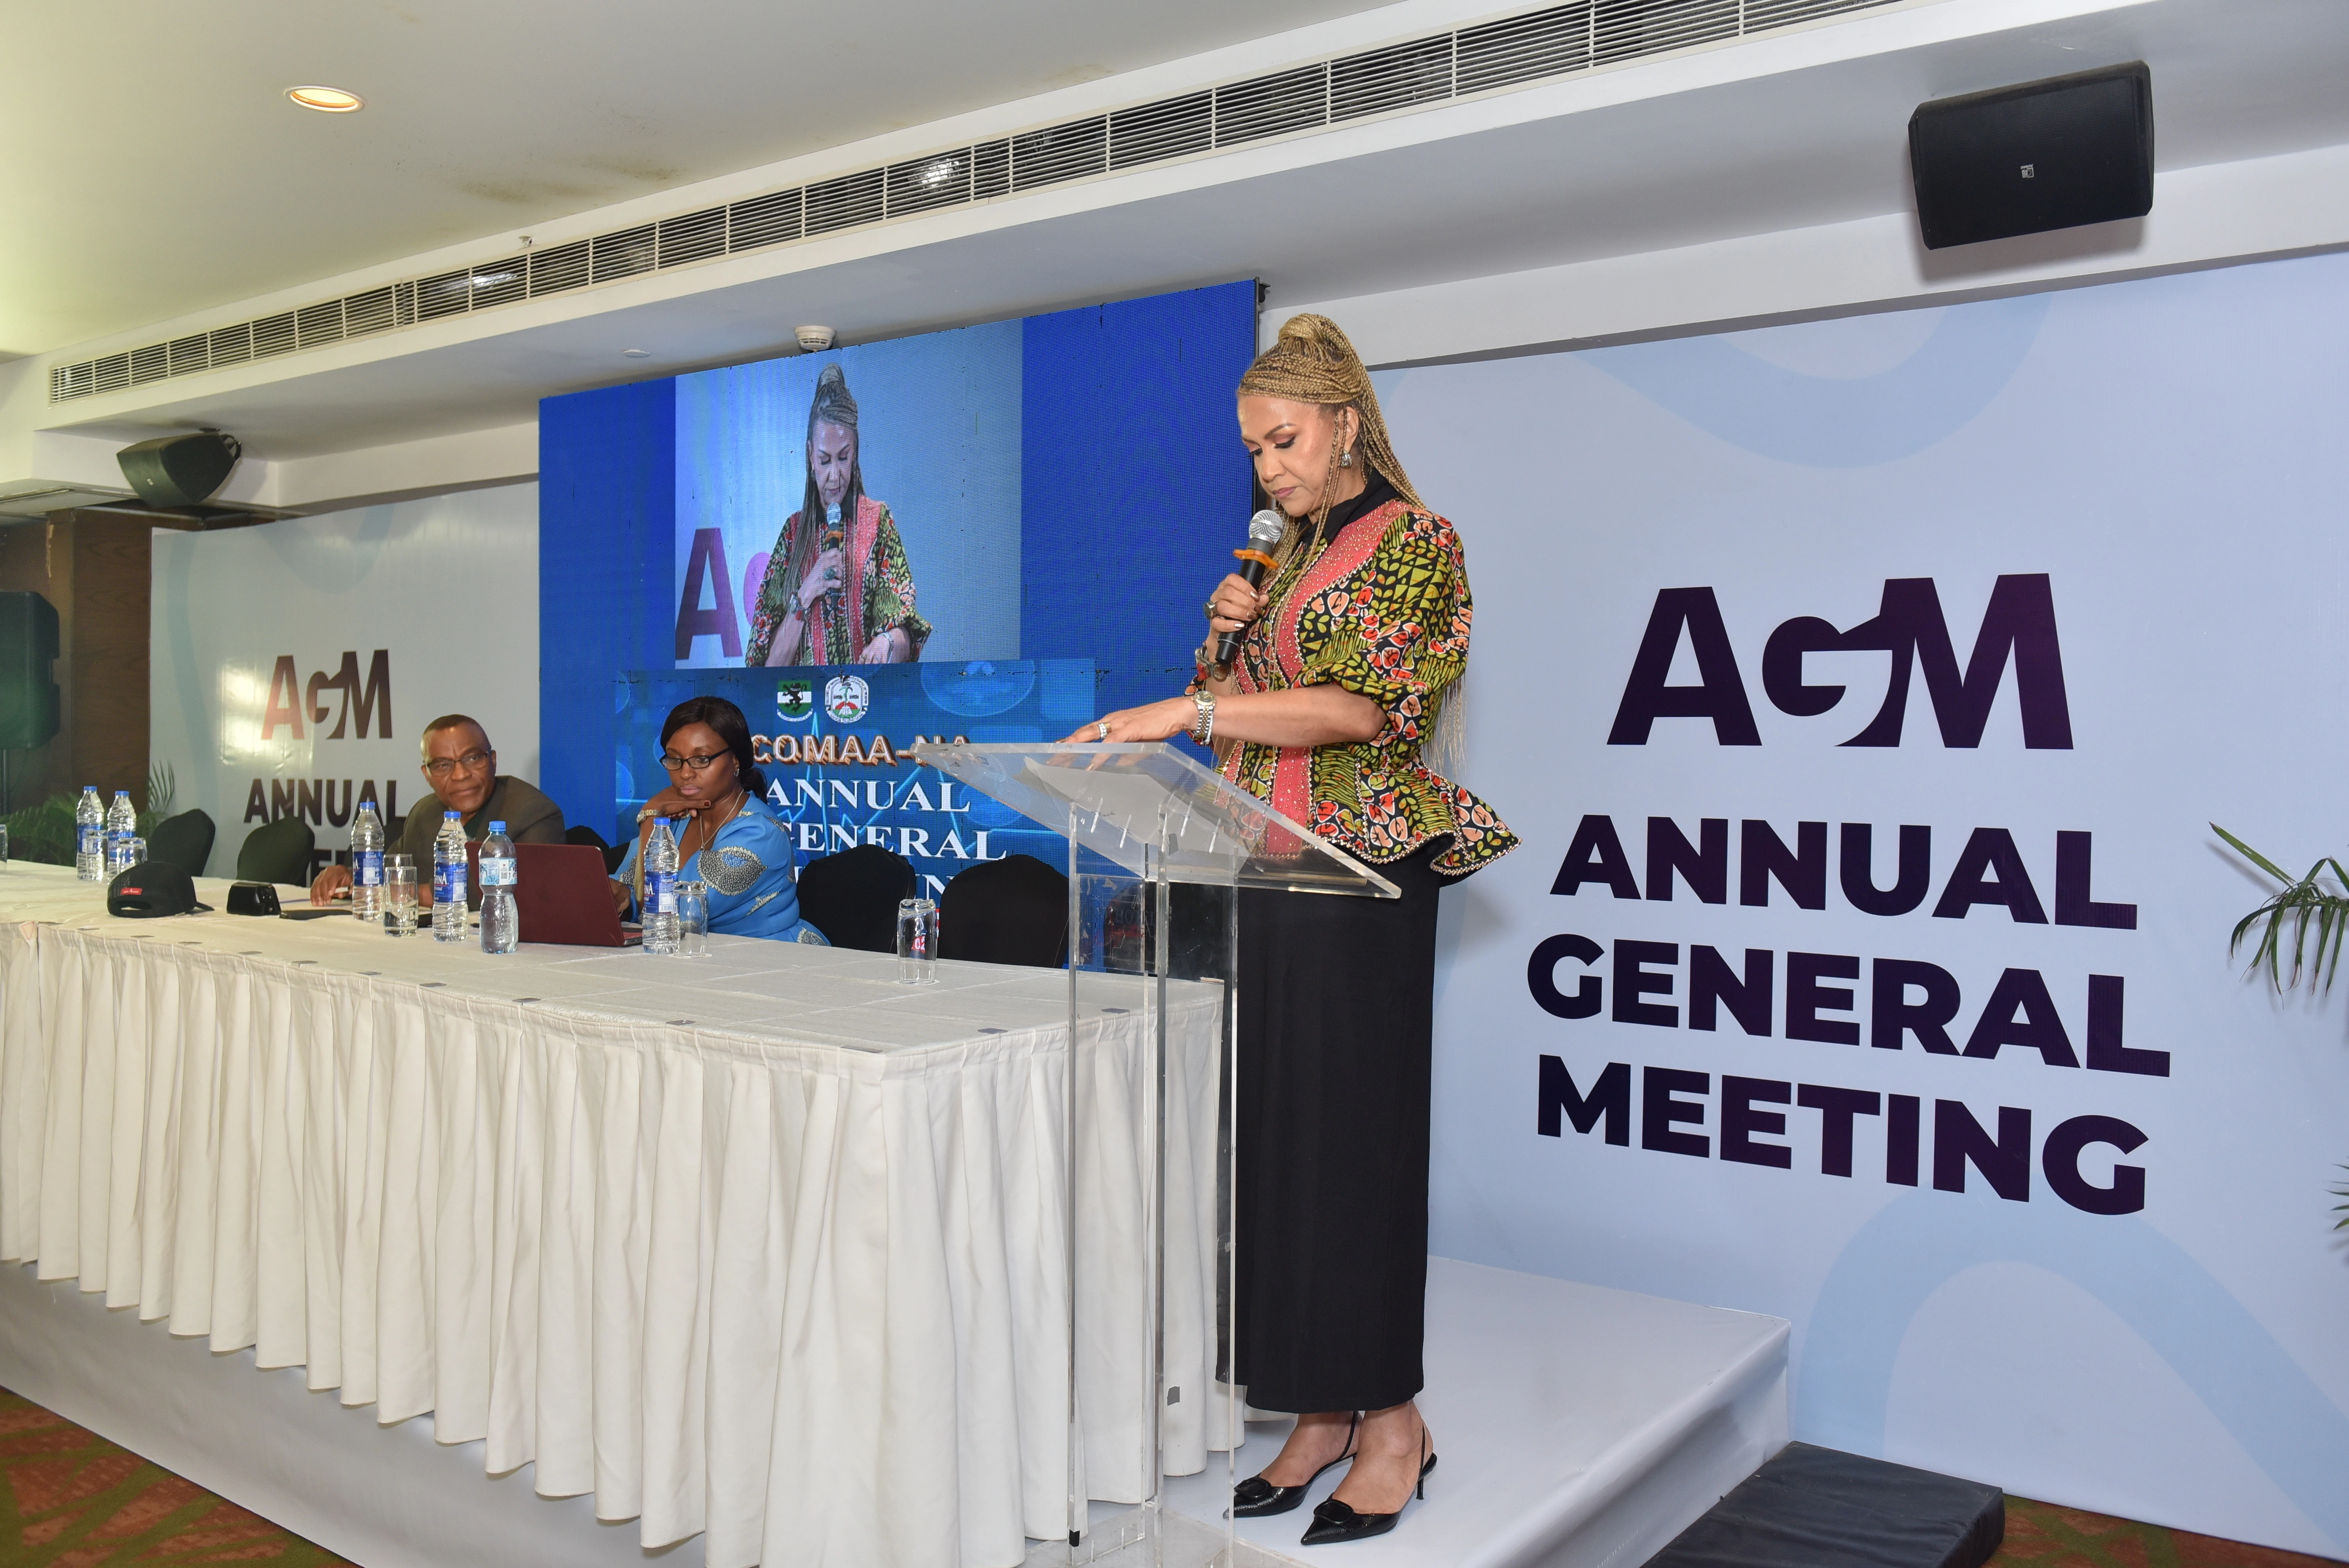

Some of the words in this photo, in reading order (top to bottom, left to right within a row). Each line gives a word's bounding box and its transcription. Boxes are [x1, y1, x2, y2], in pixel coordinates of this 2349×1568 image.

[261, 649, 392, 739] AGM
[1606, 573, 2074, 750] AGM
[244, 779, 406, 827] ANNUAL
[766, 778, 971, 812] ANNUAL
[1550, 814, 2138, 930] ANNUAL
[1527, 933, 2171, 1077] GENERAL
[1537, 1054, 2149, 1215] MEETING
